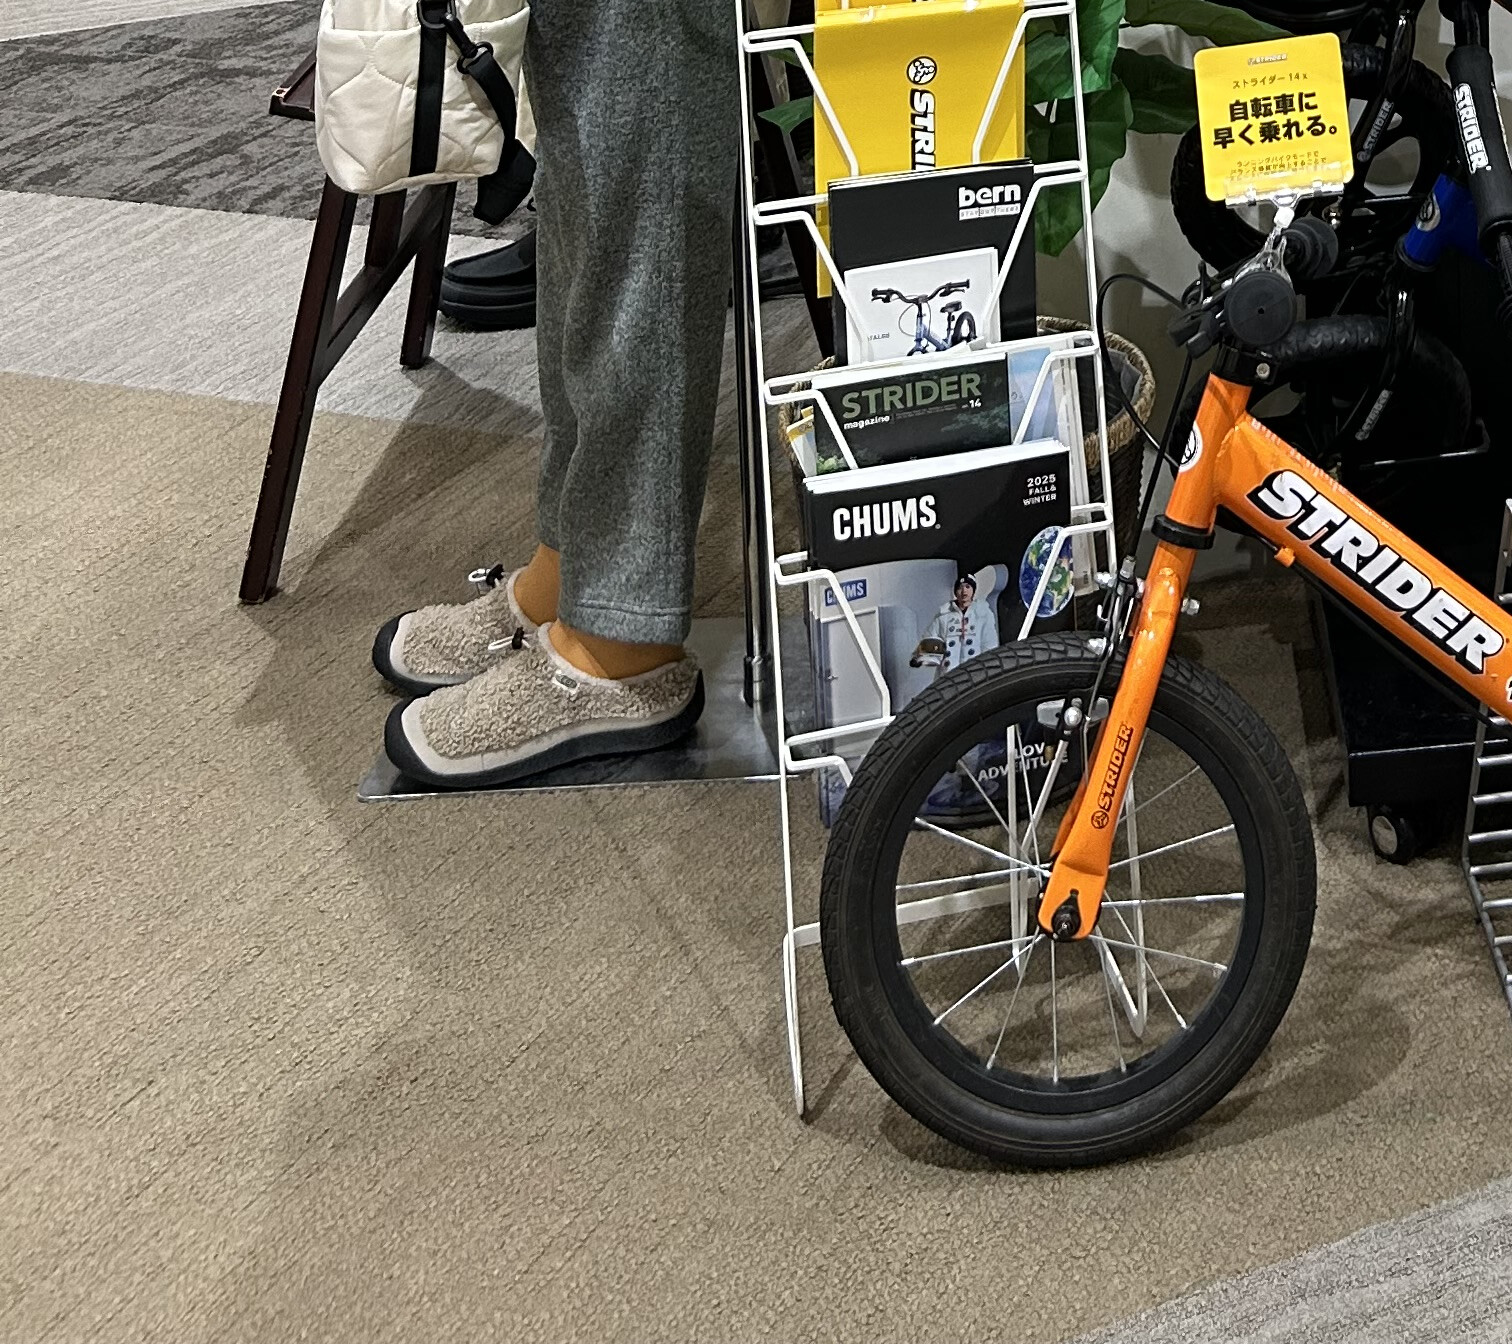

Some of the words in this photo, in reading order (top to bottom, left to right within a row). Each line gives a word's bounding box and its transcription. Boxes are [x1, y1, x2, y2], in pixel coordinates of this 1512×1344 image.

[1228, 91, 1318, 123] 自転車に
[1213, 114, 1338, 150] 早く乗れる。
[1364, 97, 1394, 154] STRIDER
[1453, 83, 1489, 174] STRIDER
[958, 184, 1021, 209] bern
[842, 373, 982, 419] STRIDER
[968, 398, 982, 409] 14
[844, 415, 890, 430] magazine
[1027, 473, 1056, 488] 2025
[833, 494, 937, 541] CHUMS
[1022, 493, 1057, 507] WINTER
[1247, 469, 1504, 674] STRIDER
[1098, 725, 1133, 811] STRIDER
